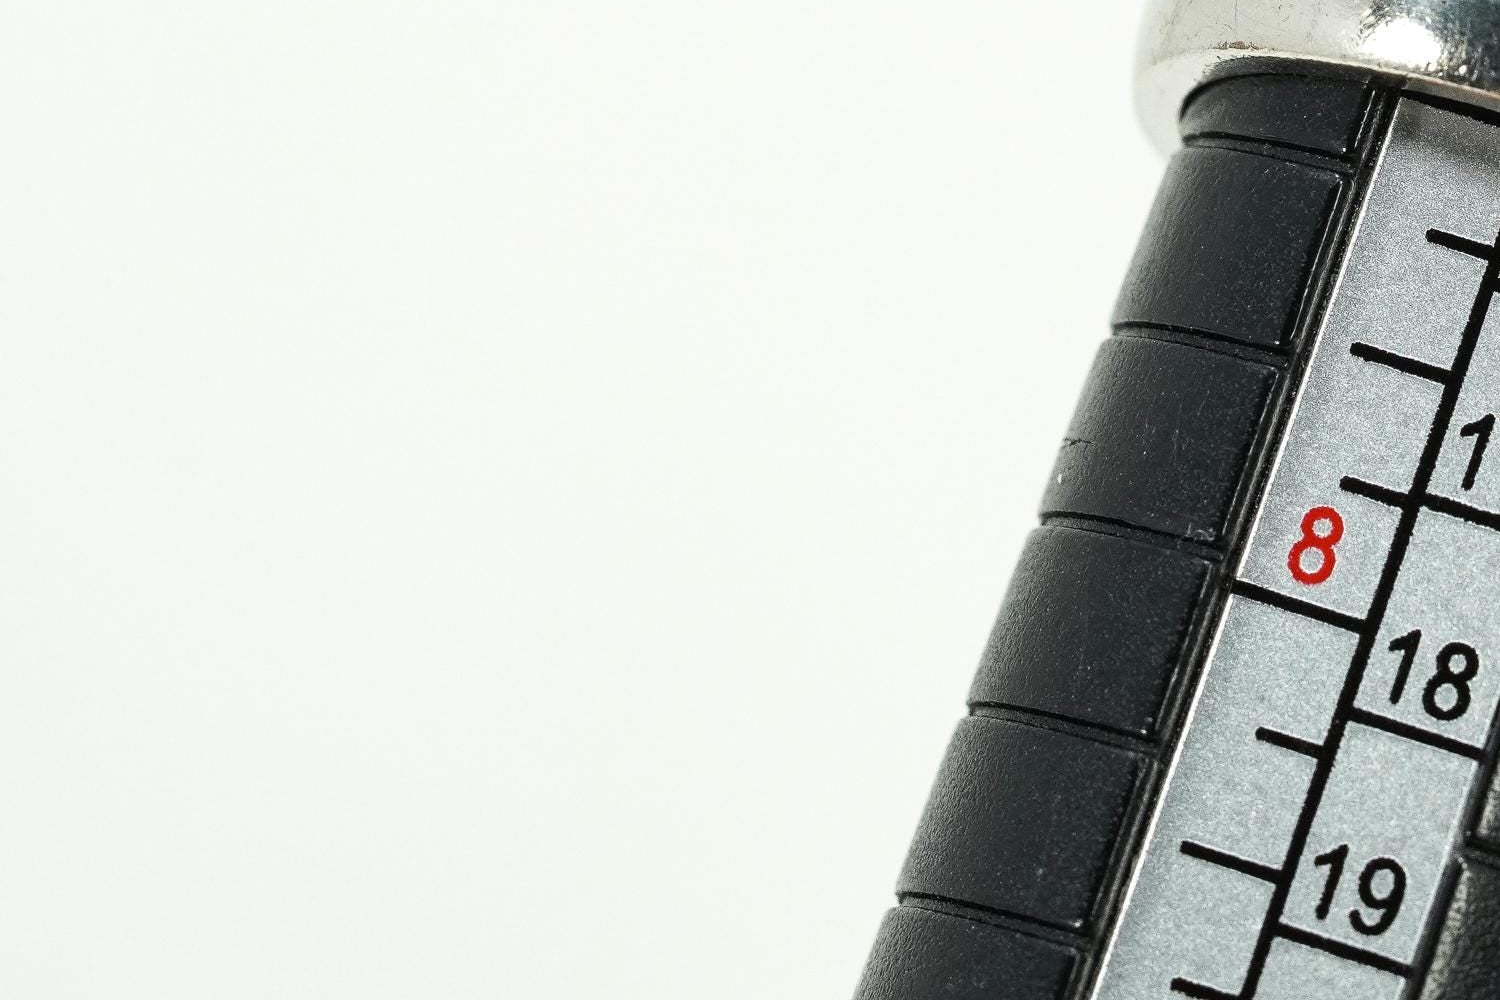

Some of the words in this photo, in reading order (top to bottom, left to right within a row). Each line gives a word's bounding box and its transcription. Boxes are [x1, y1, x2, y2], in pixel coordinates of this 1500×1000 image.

[1287, 506, 1345, 586] 8
[1387, 629, 1480, 722] 18
[1313, 844, 1407, 937] 19
